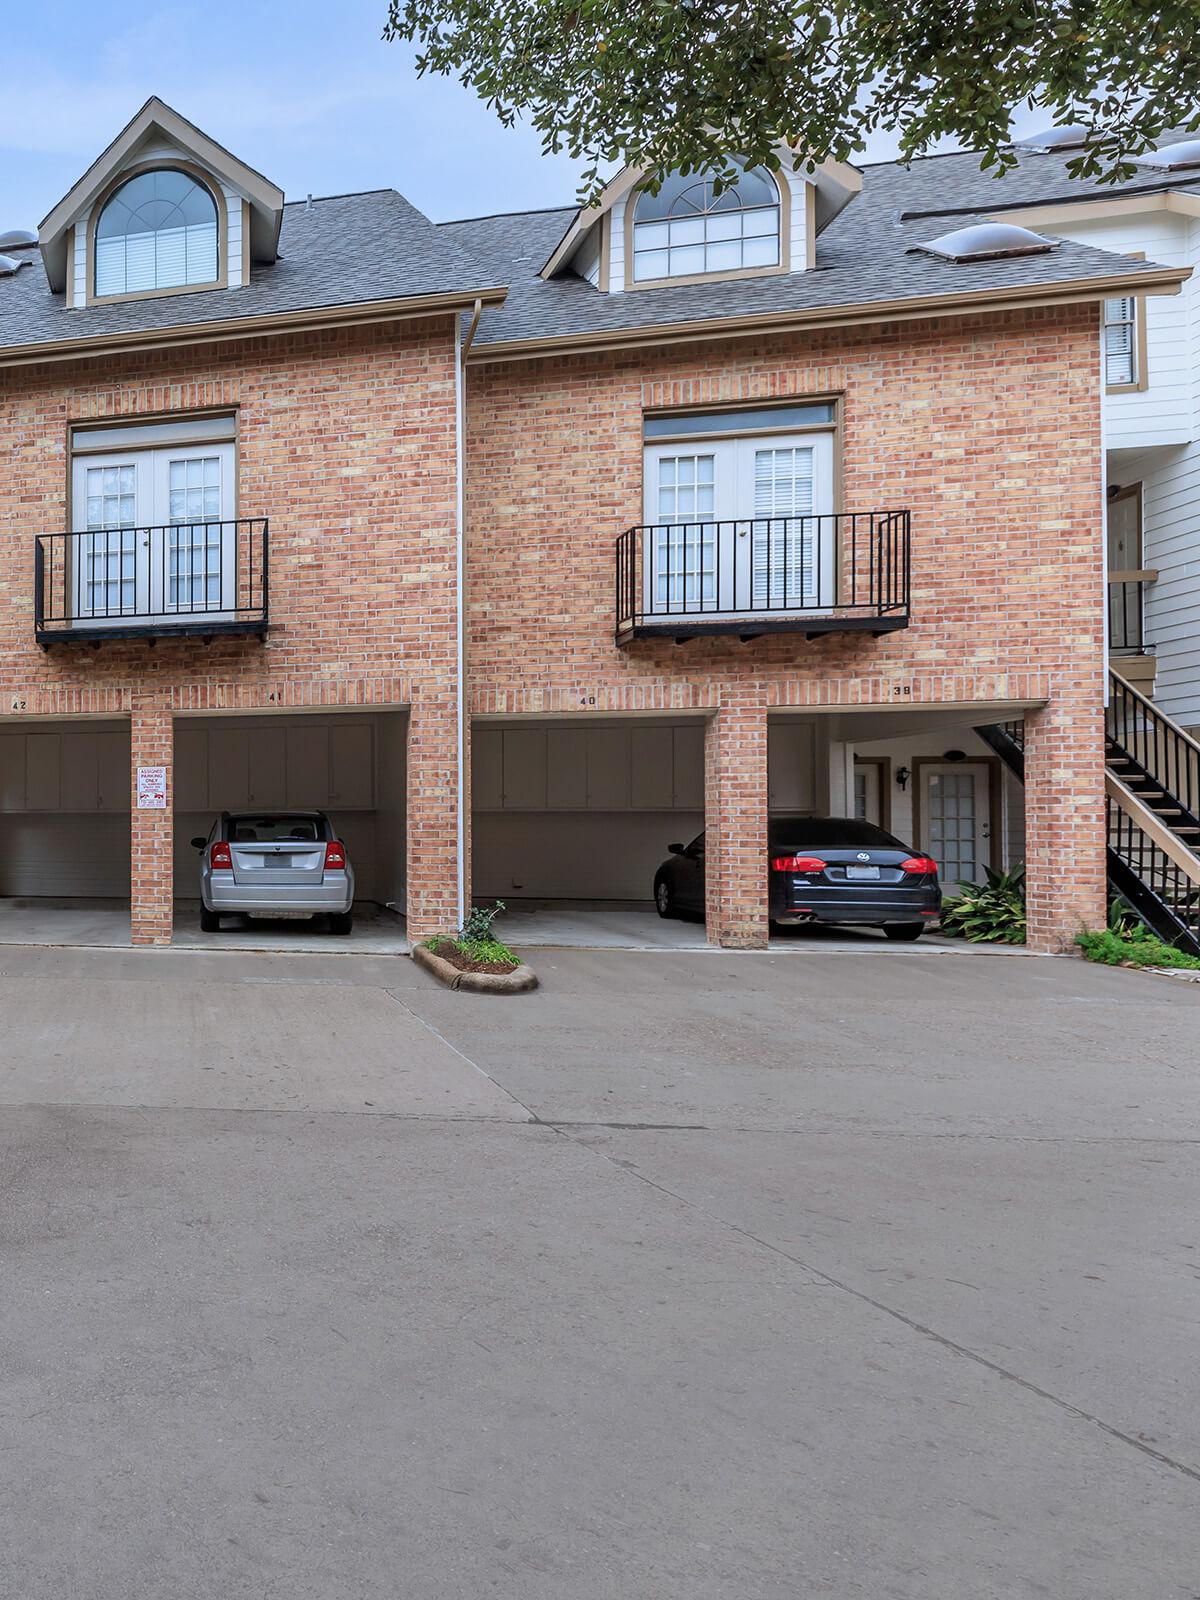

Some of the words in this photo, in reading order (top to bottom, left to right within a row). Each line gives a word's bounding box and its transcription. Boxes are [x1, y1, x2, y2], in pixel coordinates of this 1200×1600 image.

[269, 691, 282, 702] 41
[580, 696, 595, 705] 40
[13, 701, 26, 710] 42
